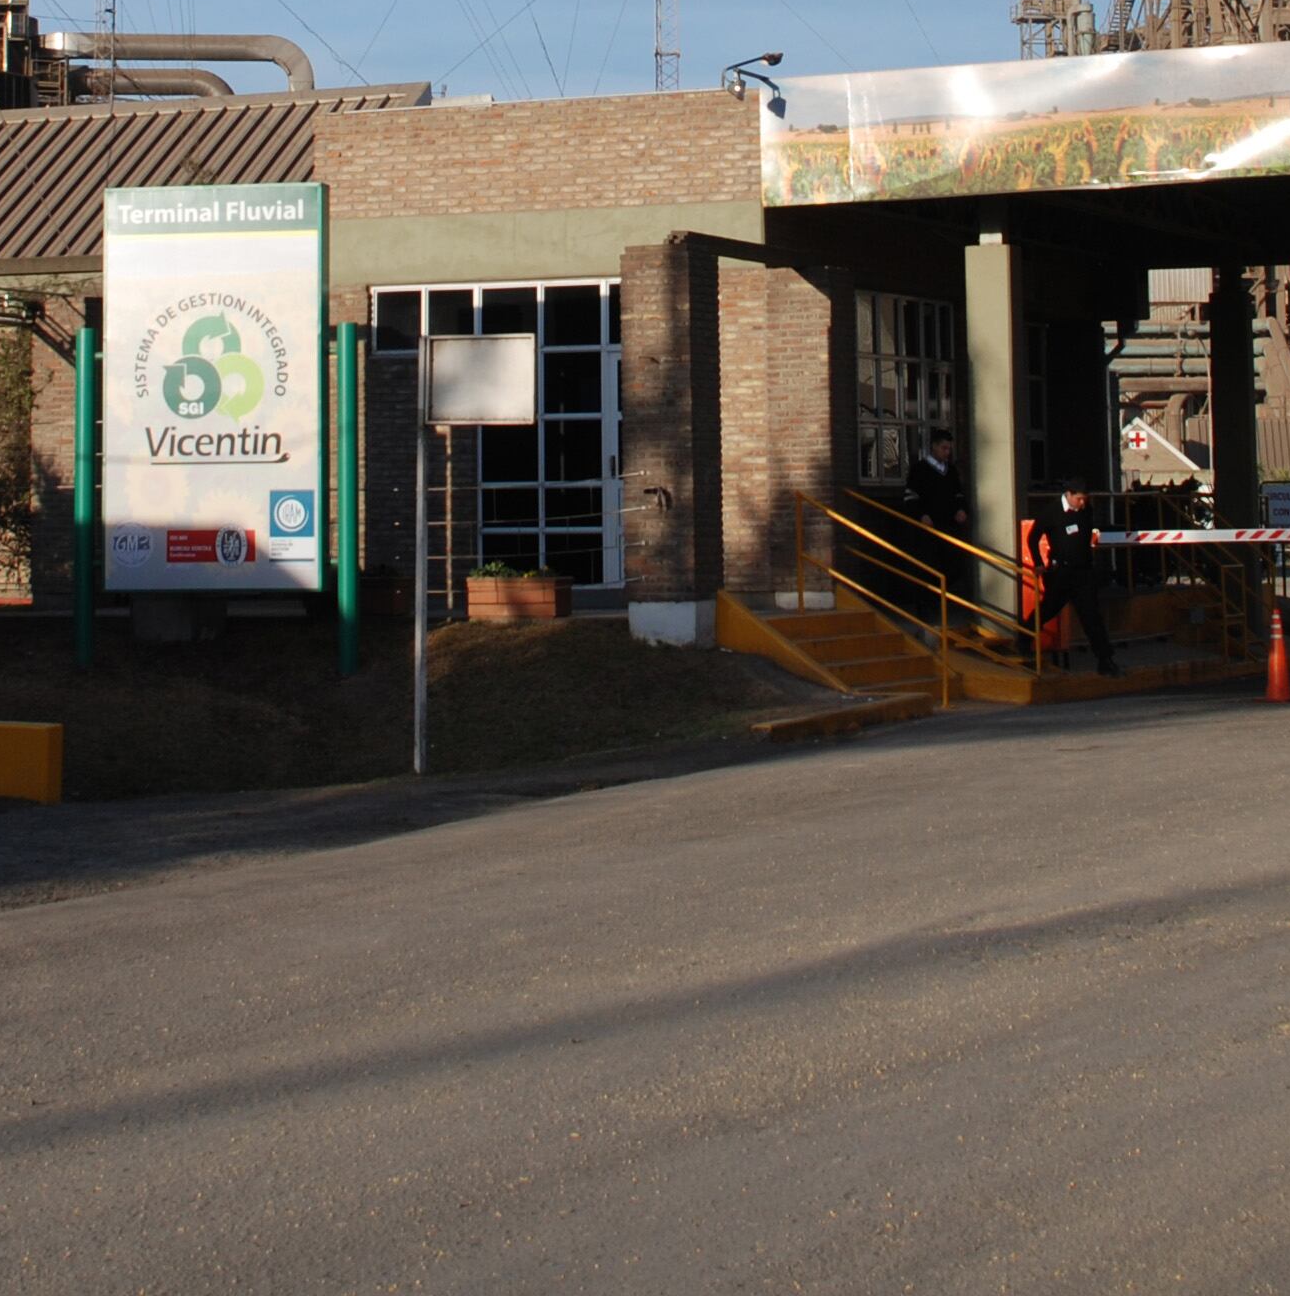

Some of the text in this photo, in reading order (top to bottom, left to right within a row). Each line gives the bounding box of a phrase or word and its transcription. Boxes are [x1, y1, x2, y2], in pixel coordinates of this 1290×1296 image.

[117, 198, 304, 224] Terminal Fluvial
[135, 292, 289, 398] SISTEMA DE GESTION INTEGRADO
[178, 402, 204, 415] SGI
[145, 425, 282, 457] Vicentin
[1273, 508, 1290, 516] CON
